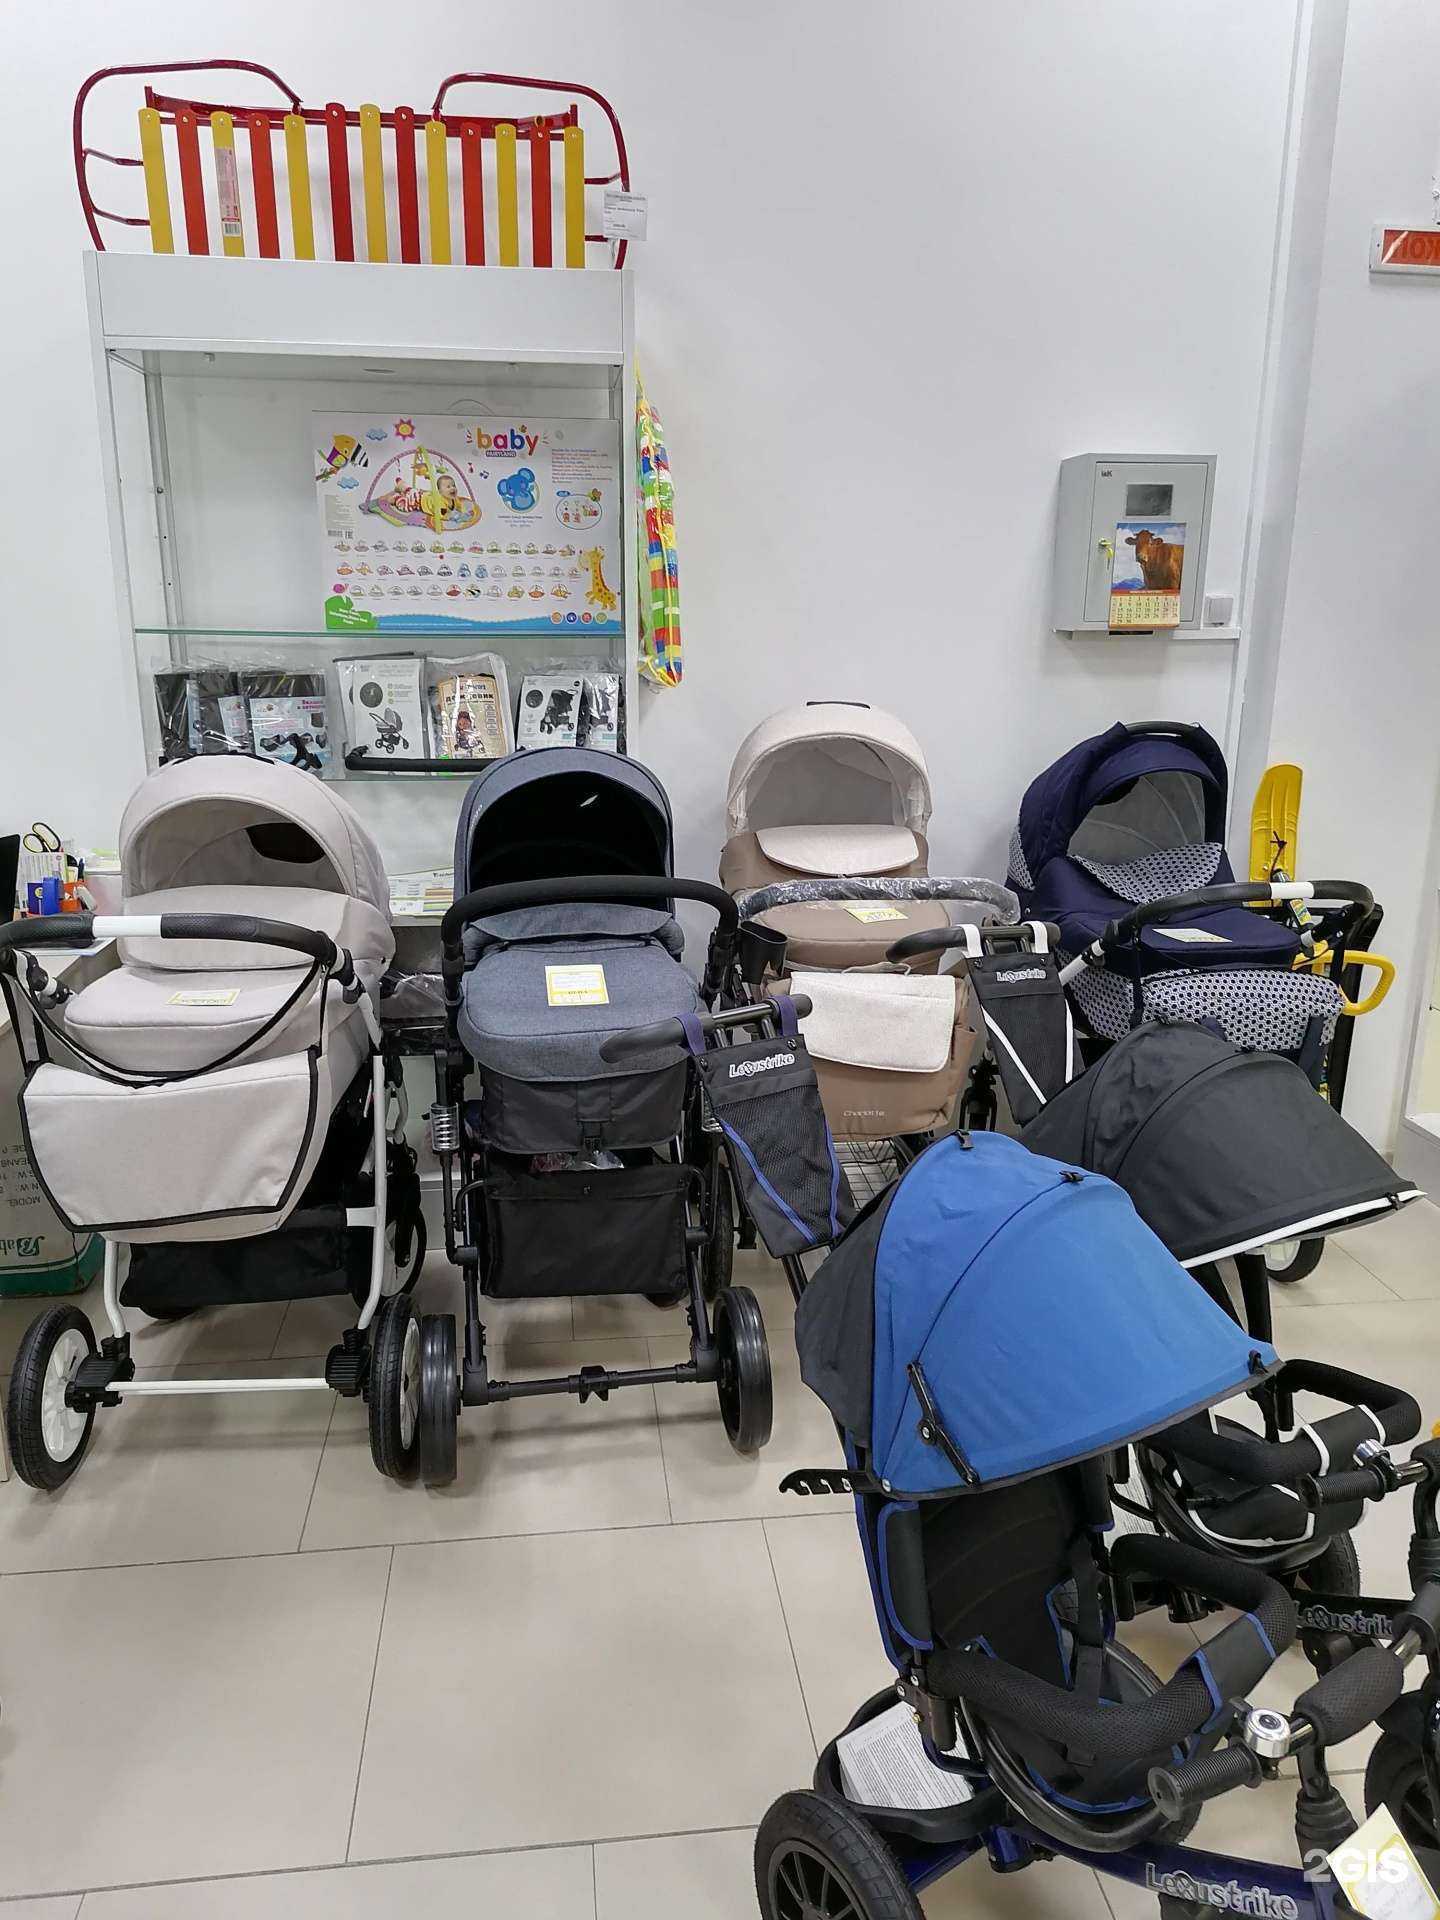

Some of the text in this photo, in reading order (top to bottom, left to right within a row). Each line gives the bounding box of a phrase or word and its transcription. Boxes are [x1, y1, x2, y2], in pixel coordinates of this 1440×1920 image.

[477, 427, 540, 456] baby
[729, 1054, 795, 1077] Lexustrike
[1145, 1862, 1298, 1920] Lexustrike
